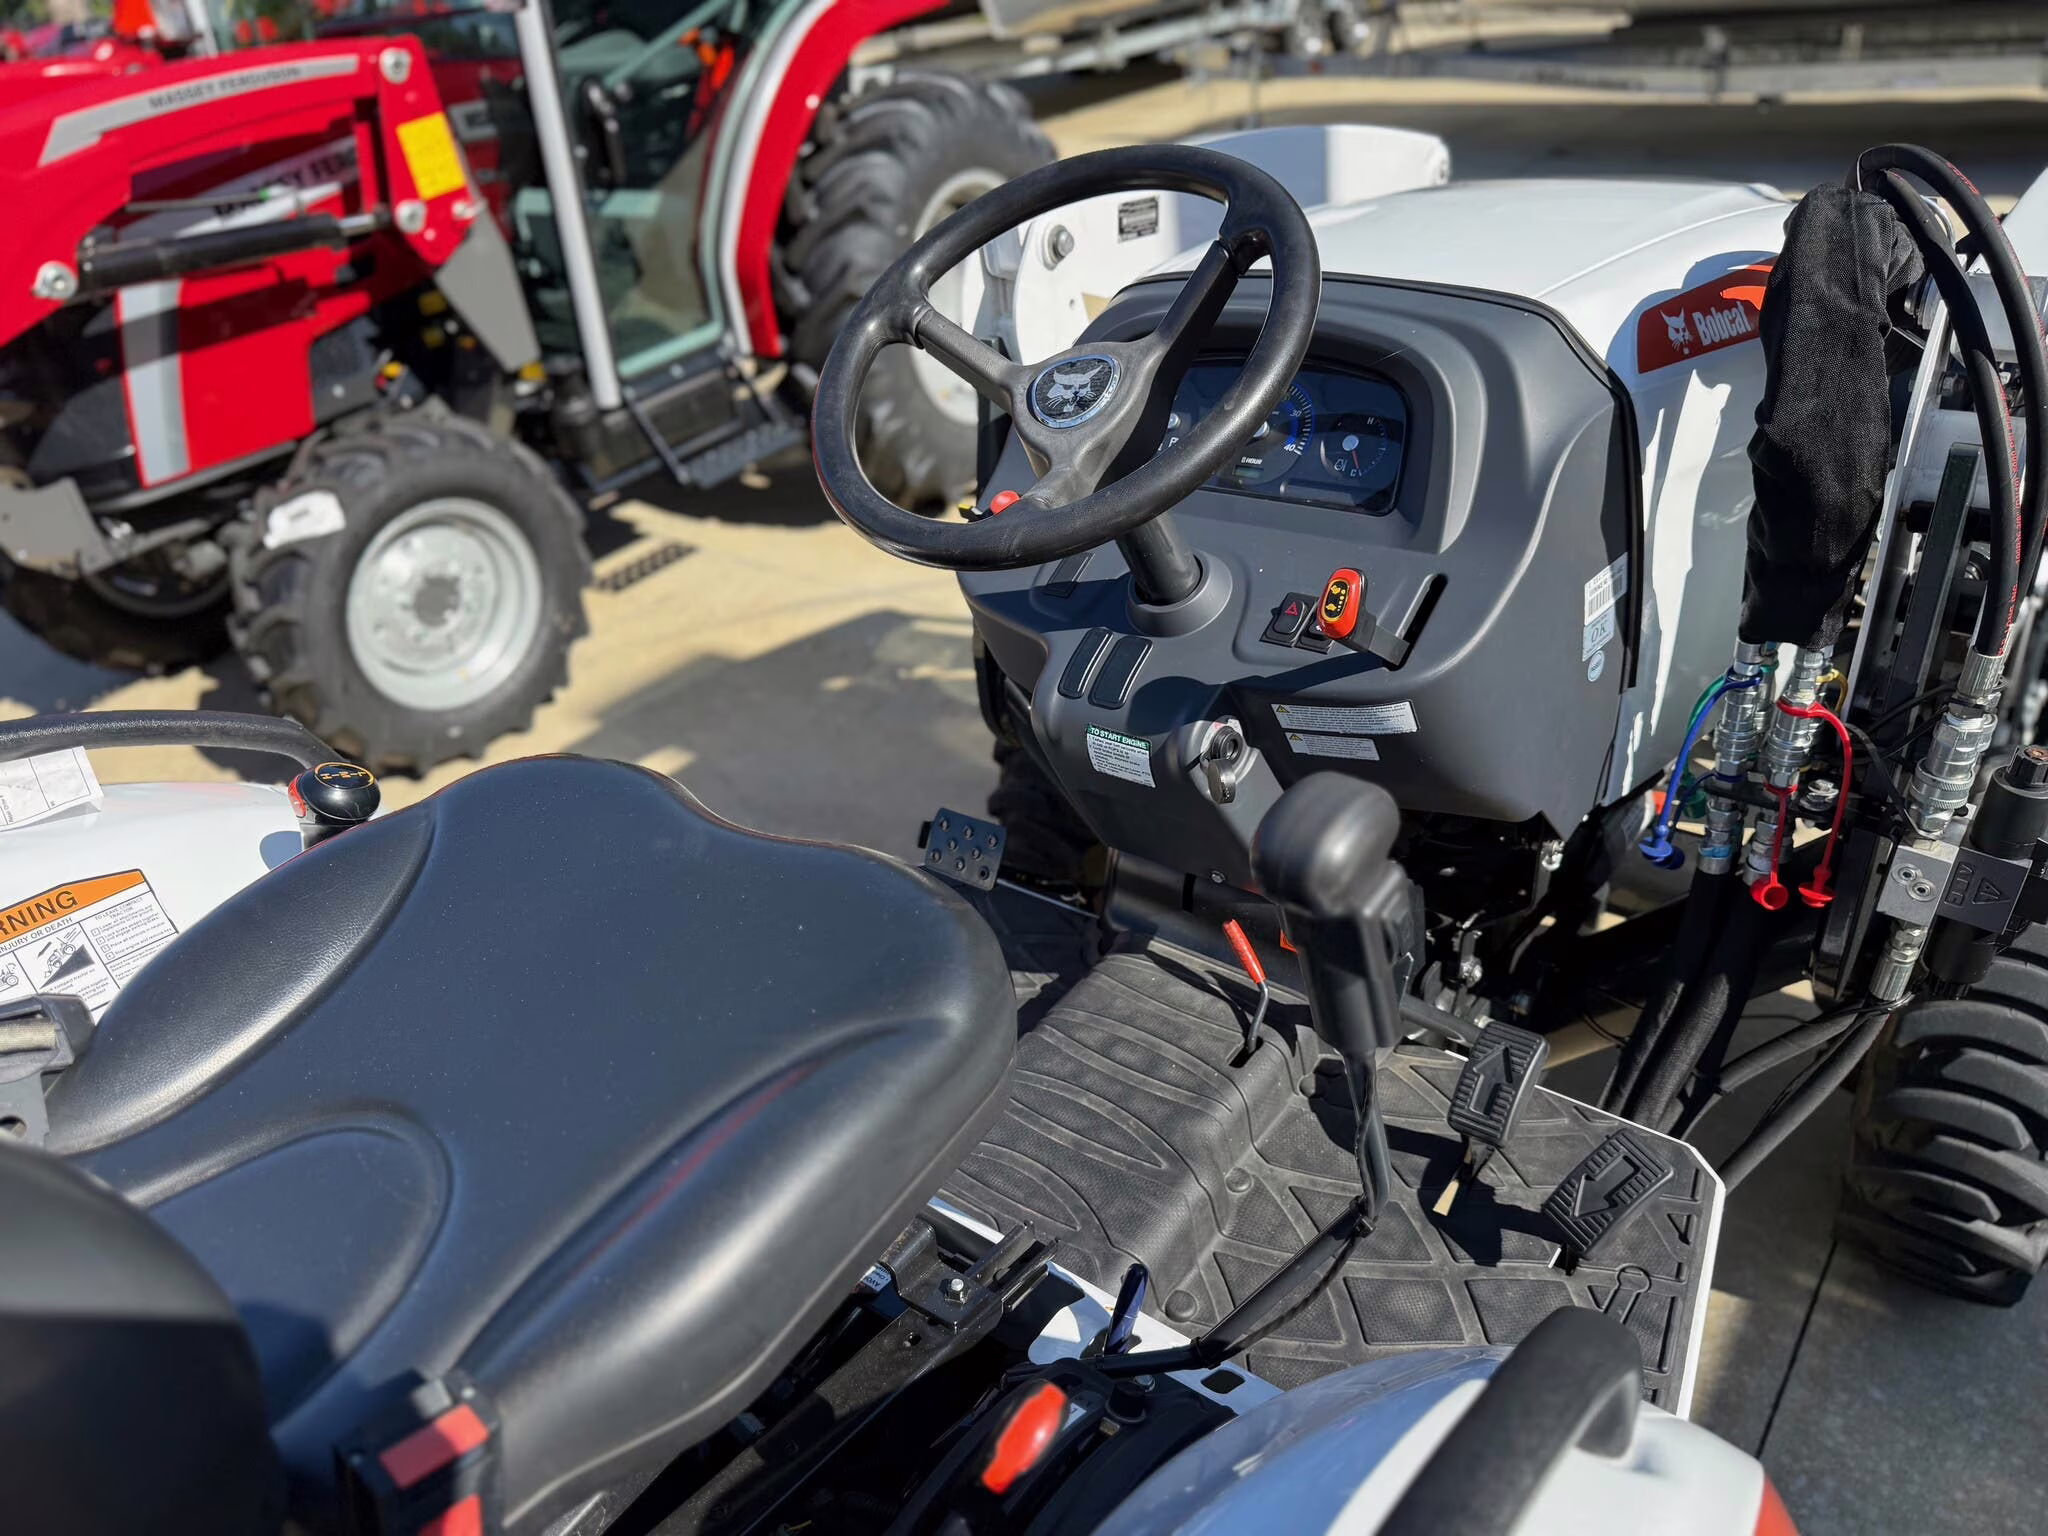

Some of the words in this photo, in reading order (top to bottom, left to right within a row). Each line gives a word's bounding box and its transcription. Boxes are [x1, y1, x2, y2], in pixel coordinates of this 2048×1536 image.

[1692, 301, 1752, 346] Bobcat
[1284, 443, 1296, 452] 40
[1090, 727, 1100, 736] TO
[1100, 731, 1121, 742] START
[1122, 736, 1147, 749] ENGINE
[31, 930, 44, 939] OR
[45, 918, 73, 933] DEATH
